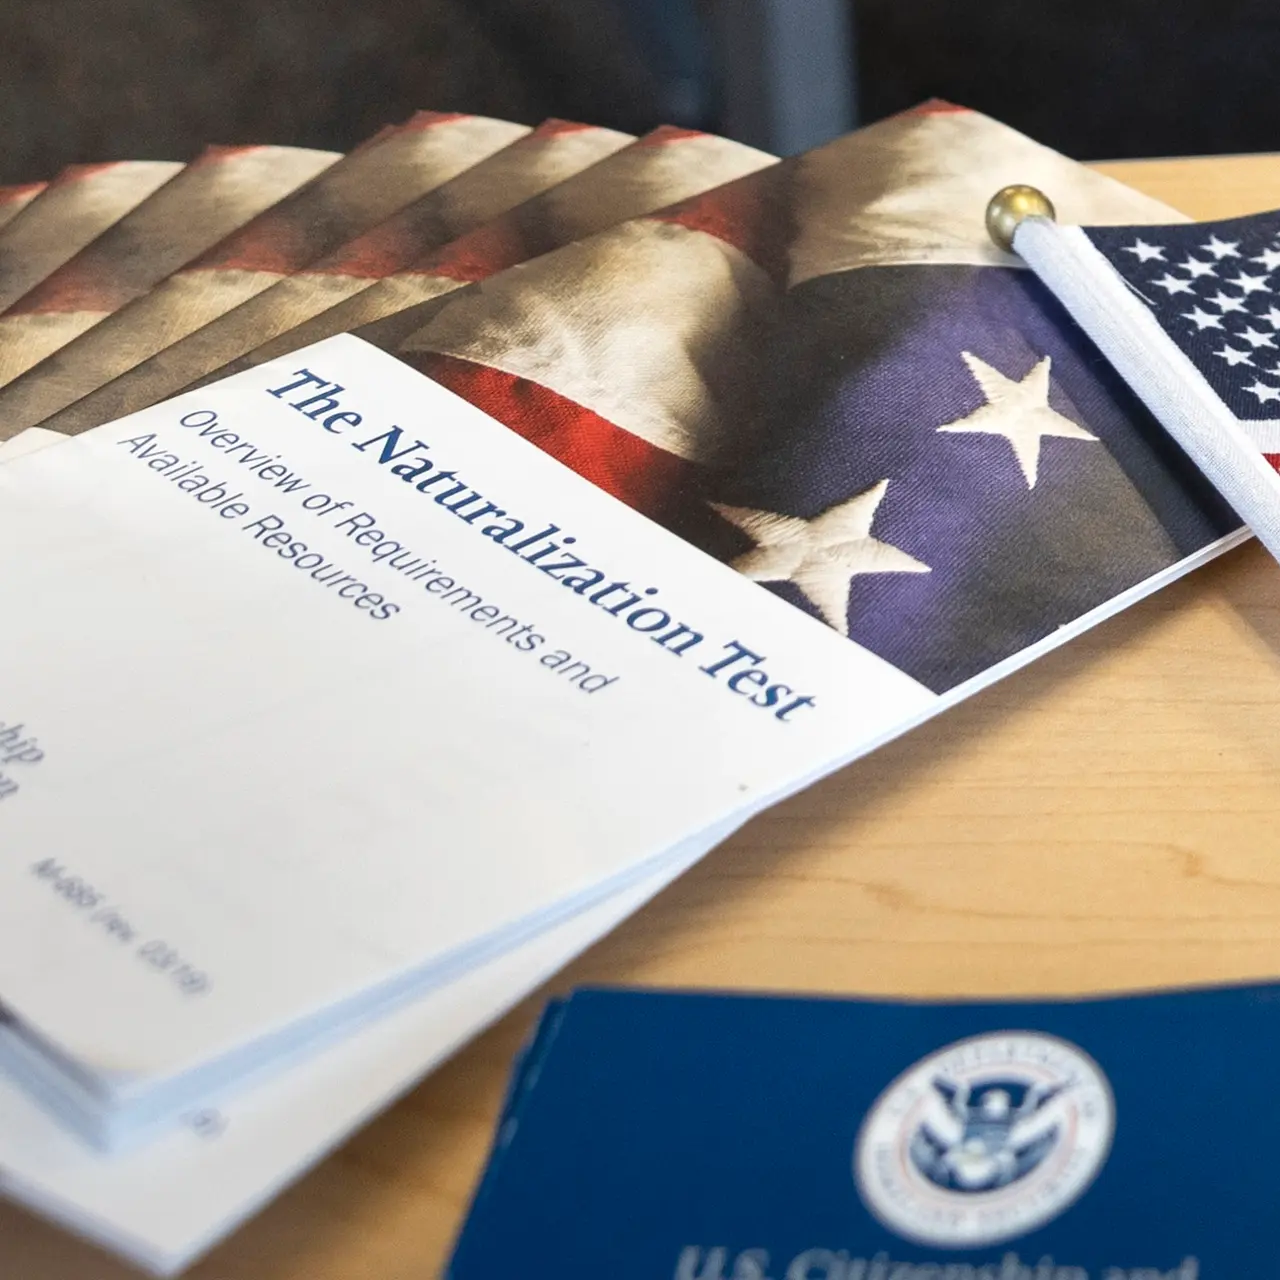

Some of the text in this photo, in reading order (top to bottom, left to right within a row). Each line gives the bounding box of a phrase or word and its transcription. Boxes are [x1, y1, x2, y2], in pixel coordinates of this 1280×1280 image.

[116, 432, 401, 621] Available Resources
[179, 409, 621, 695] Overview of Requirements and
[265, 367, 817, 722] The Naturalization Test
